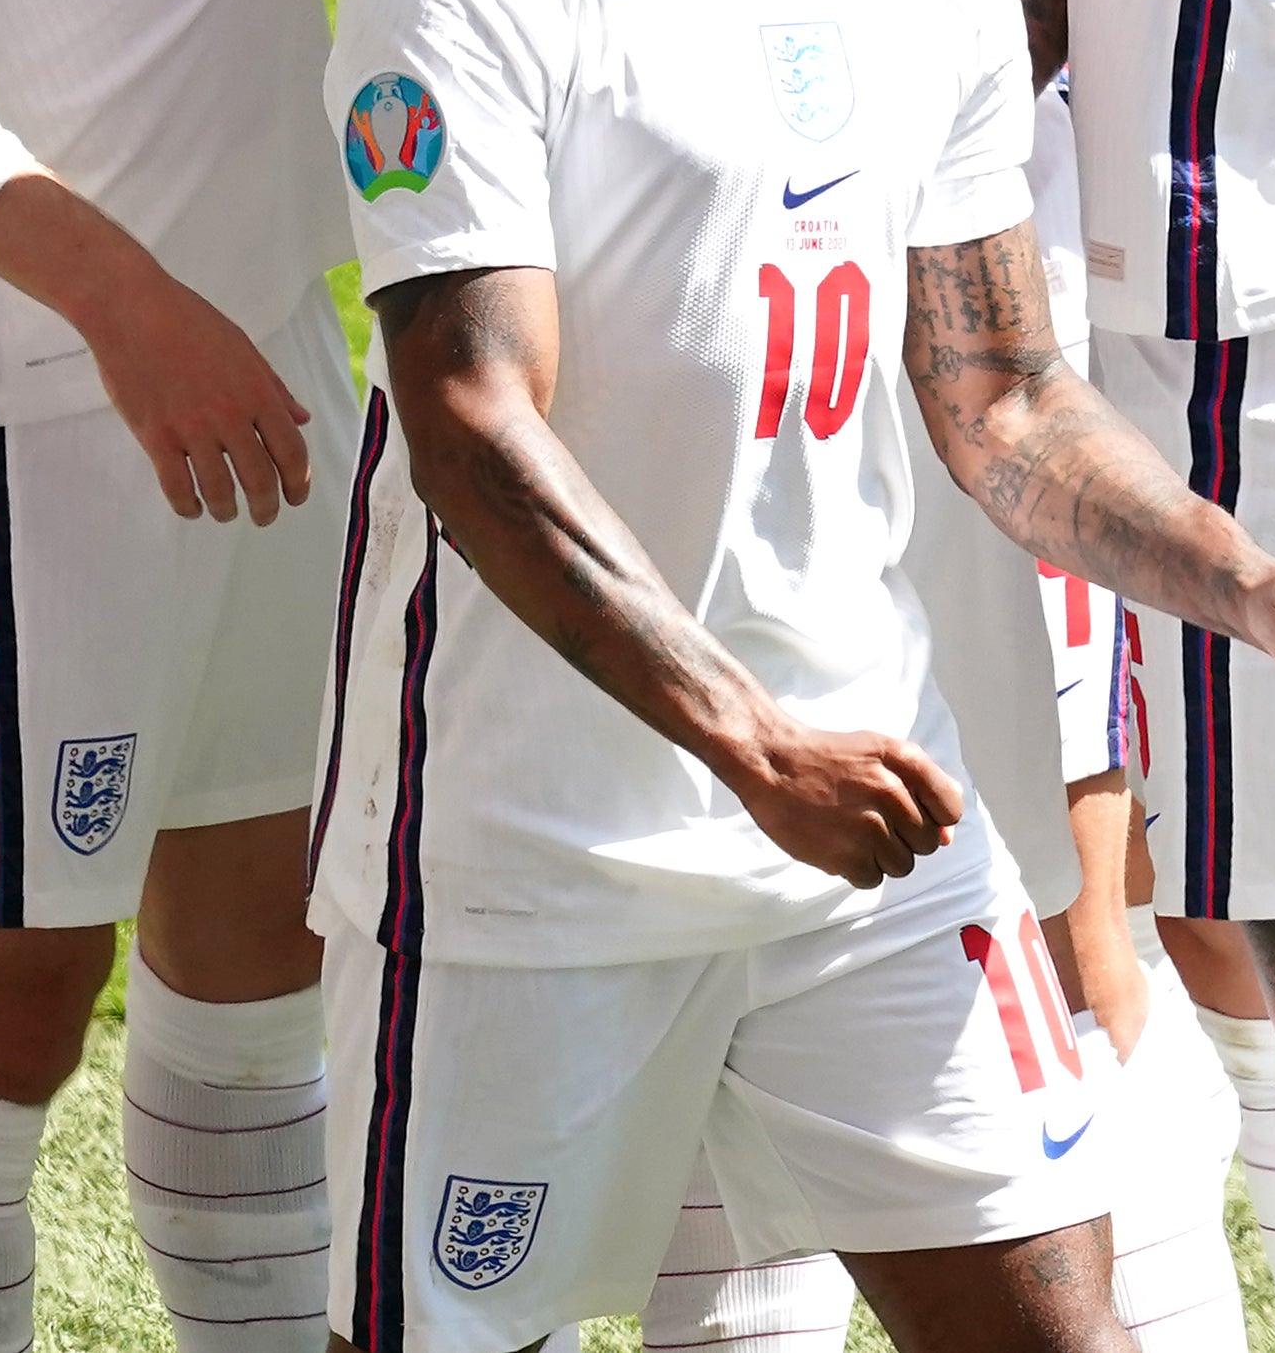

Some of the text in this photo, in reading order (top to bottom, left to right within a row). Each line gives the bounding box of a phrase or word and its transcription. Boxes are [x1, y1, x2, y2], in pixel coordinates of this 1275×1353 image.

[794, 220, 839, 233] CROATIA
[799, 237, 824, 250] JUNE
[755, 260, 871, 440] 10
[960, 908, 1083, 1094] 10
